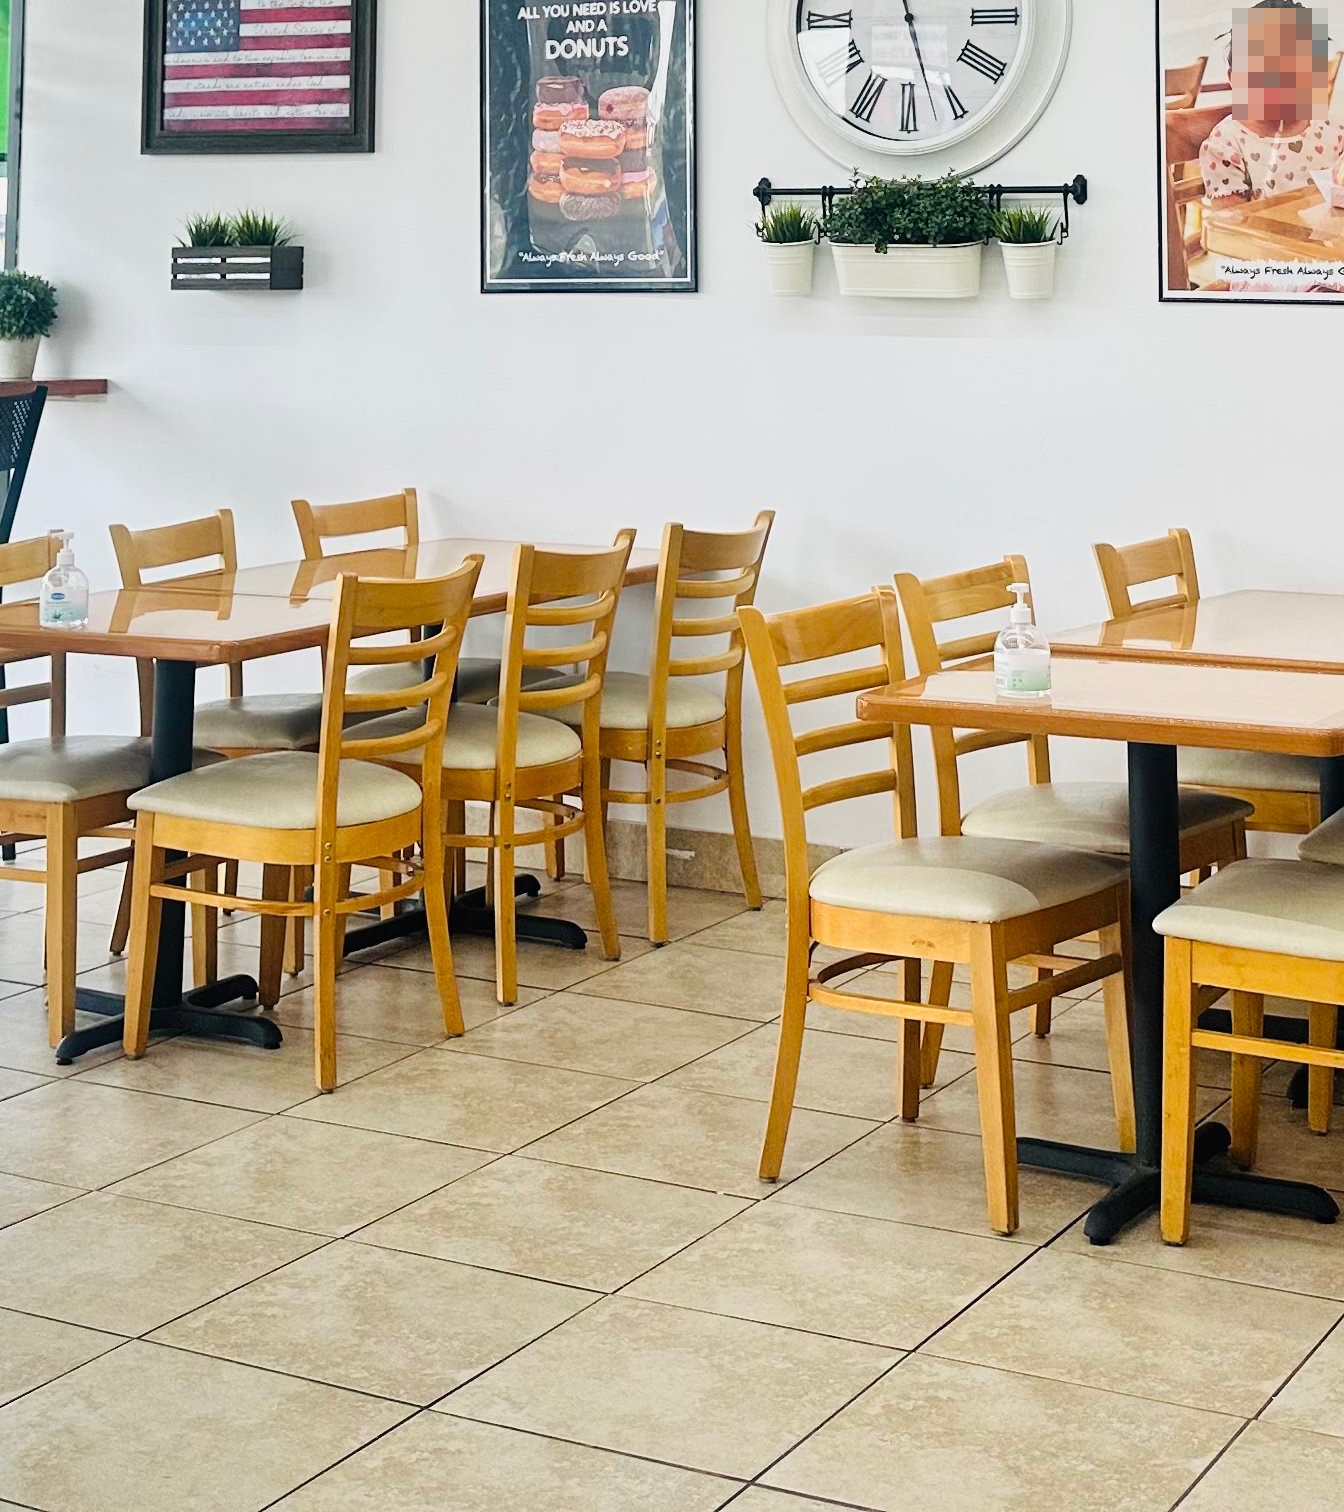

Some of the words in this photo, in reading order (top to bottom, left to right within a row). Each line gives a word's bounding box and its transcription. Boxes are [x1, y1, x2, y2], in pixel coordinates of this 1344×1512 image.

[517, 6, 541, 20] ALL
[542, 4, 570, 18] YOU
[572, 2, 607, 16] NEED
[609, 0, 622, 14] IS
[622, 0, 657, 14] LOVE
[566, 20, 595, 34] AND
[596, 18, 608, 32] A
[545, 35, 630, 60] DONUTS
[589, 249, 625, 267] Always
[1264, 265, 1293, 276] Fresh
[1297, 265, 1335, 281] Always
